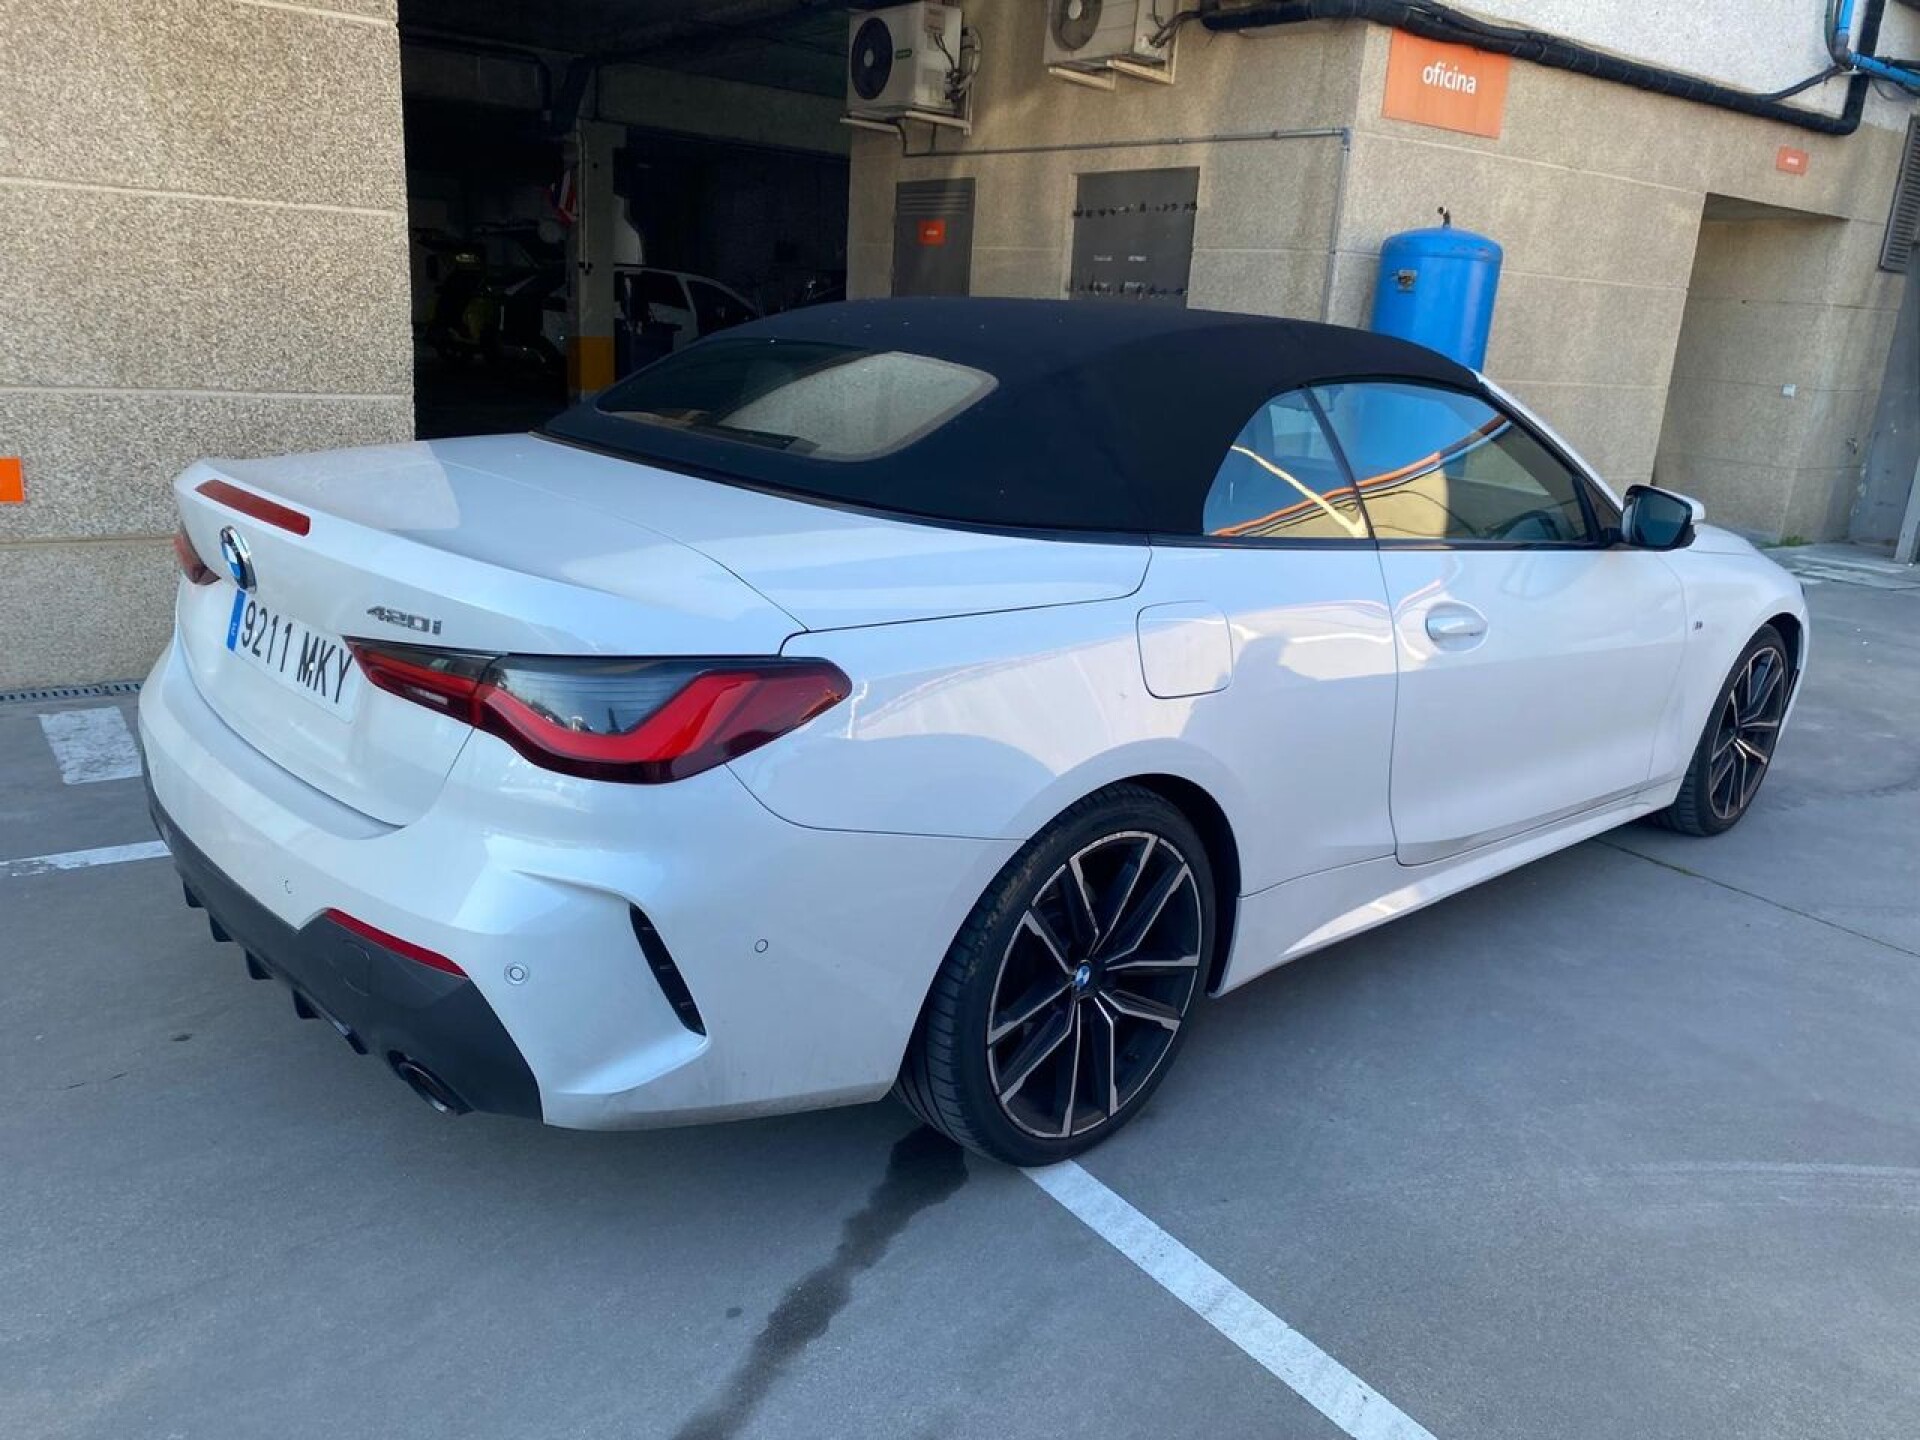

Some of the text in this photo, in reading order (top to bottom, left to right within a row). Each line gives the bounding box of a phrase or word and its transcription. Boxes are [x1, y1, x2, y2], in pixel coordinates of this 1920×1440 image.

[1422, 61, 1477, 94] oficina
[366, 605, 442, 635] 420i
[241, 600, 353, 704] 9211 MKY
